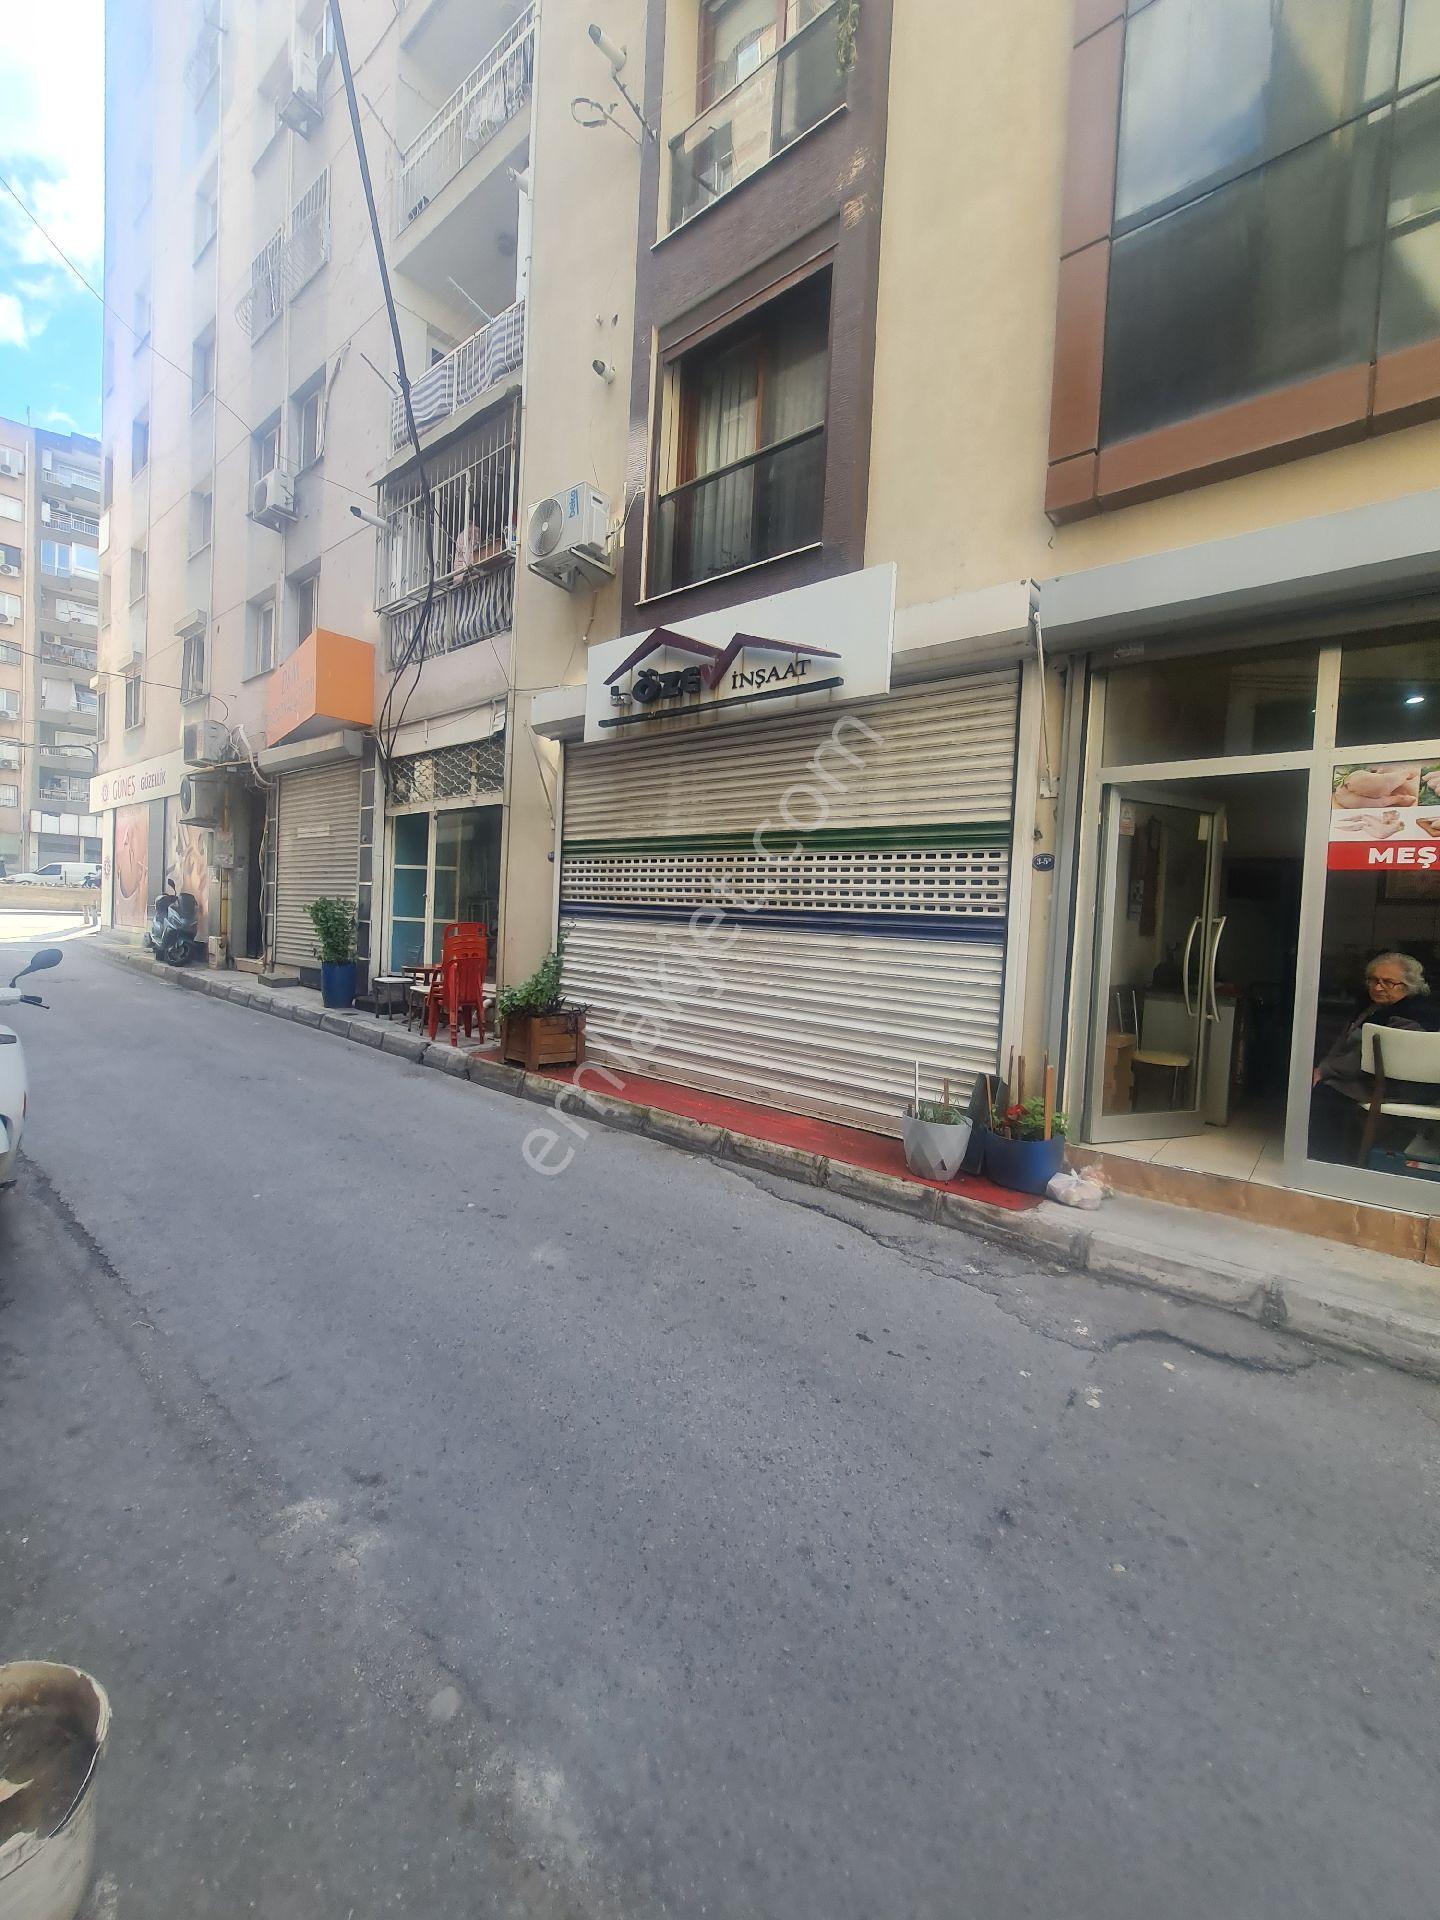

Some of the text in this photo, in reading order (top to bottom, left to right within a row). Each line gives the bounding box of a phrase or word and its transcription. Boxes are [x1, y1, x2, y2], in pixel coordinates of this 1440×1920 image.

[568, 489, 576, 518] beko
[731, 659, 812, 690] İNŞAAT
[112, 768, 167, 800] GÜNEŞ GÜZELLİK
[1368, 847, 1438, 869] MEŞ
